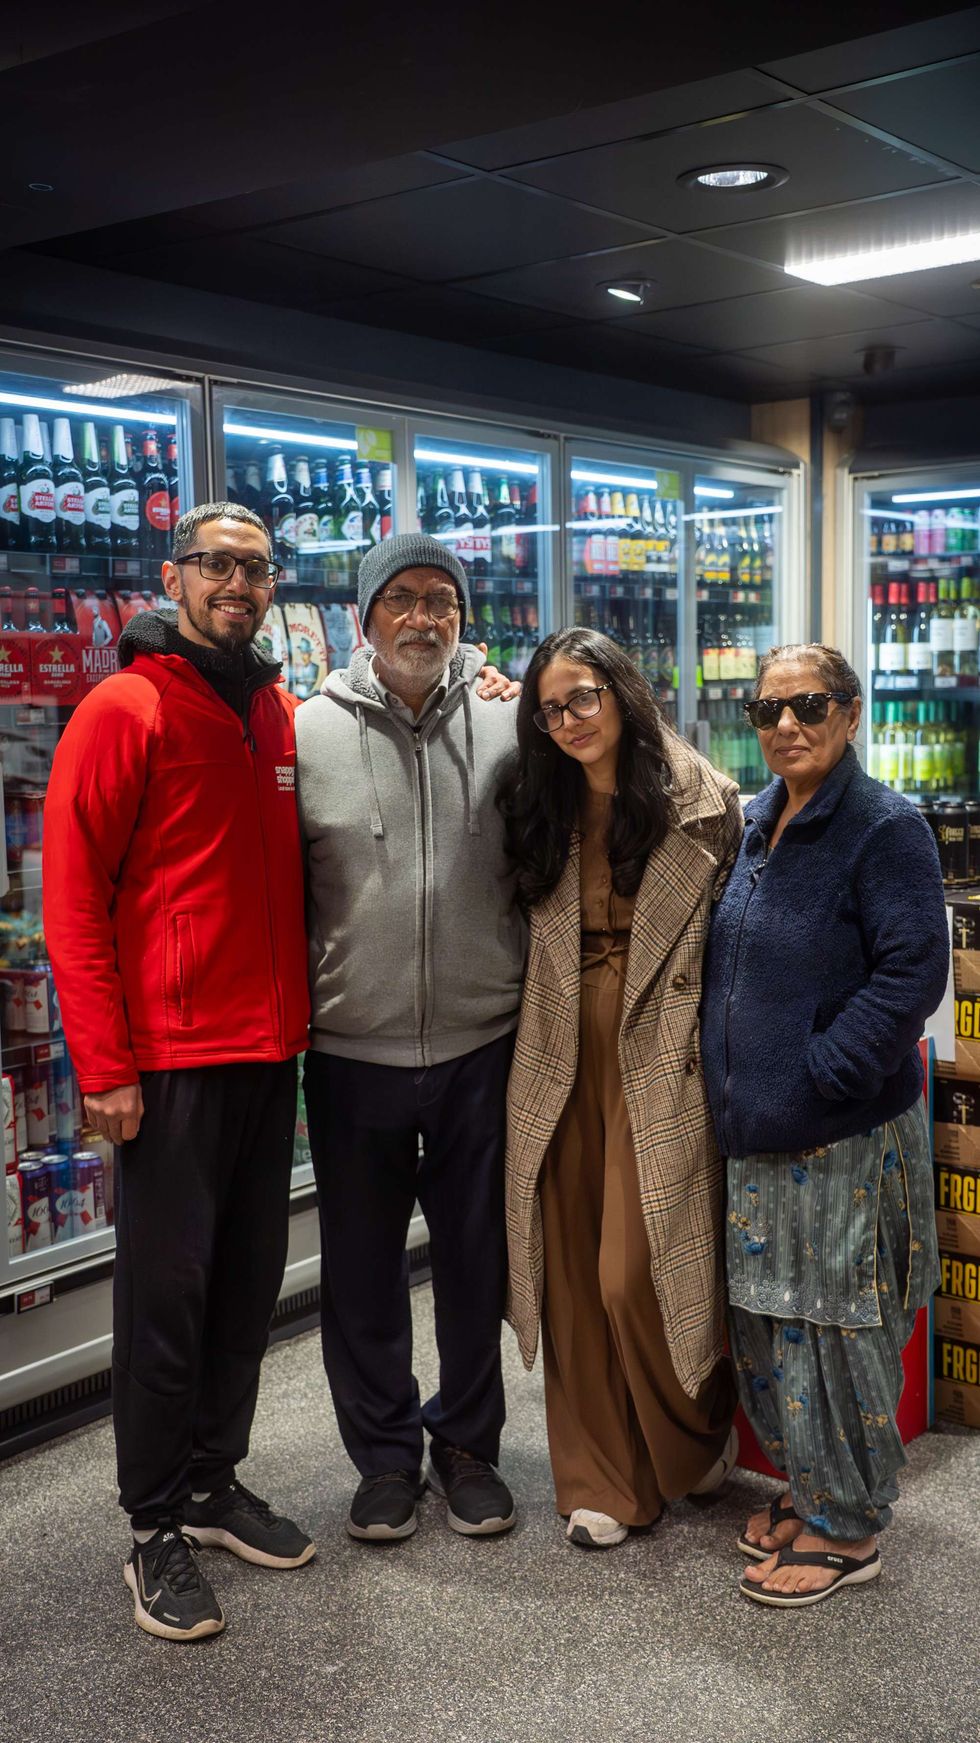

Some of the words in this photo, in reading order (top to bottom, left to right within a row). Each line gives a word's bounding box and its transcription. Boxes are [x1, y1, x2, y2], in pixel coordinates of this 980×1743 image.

[0, 663, 23, 672] RELLA
[39, 663, 75, 672] ESTRELLA
[82, 649, 121, 673] MADR
[941, 1257, 980, 1300] FRG
[942, 1342, 980, 1385] FRG
